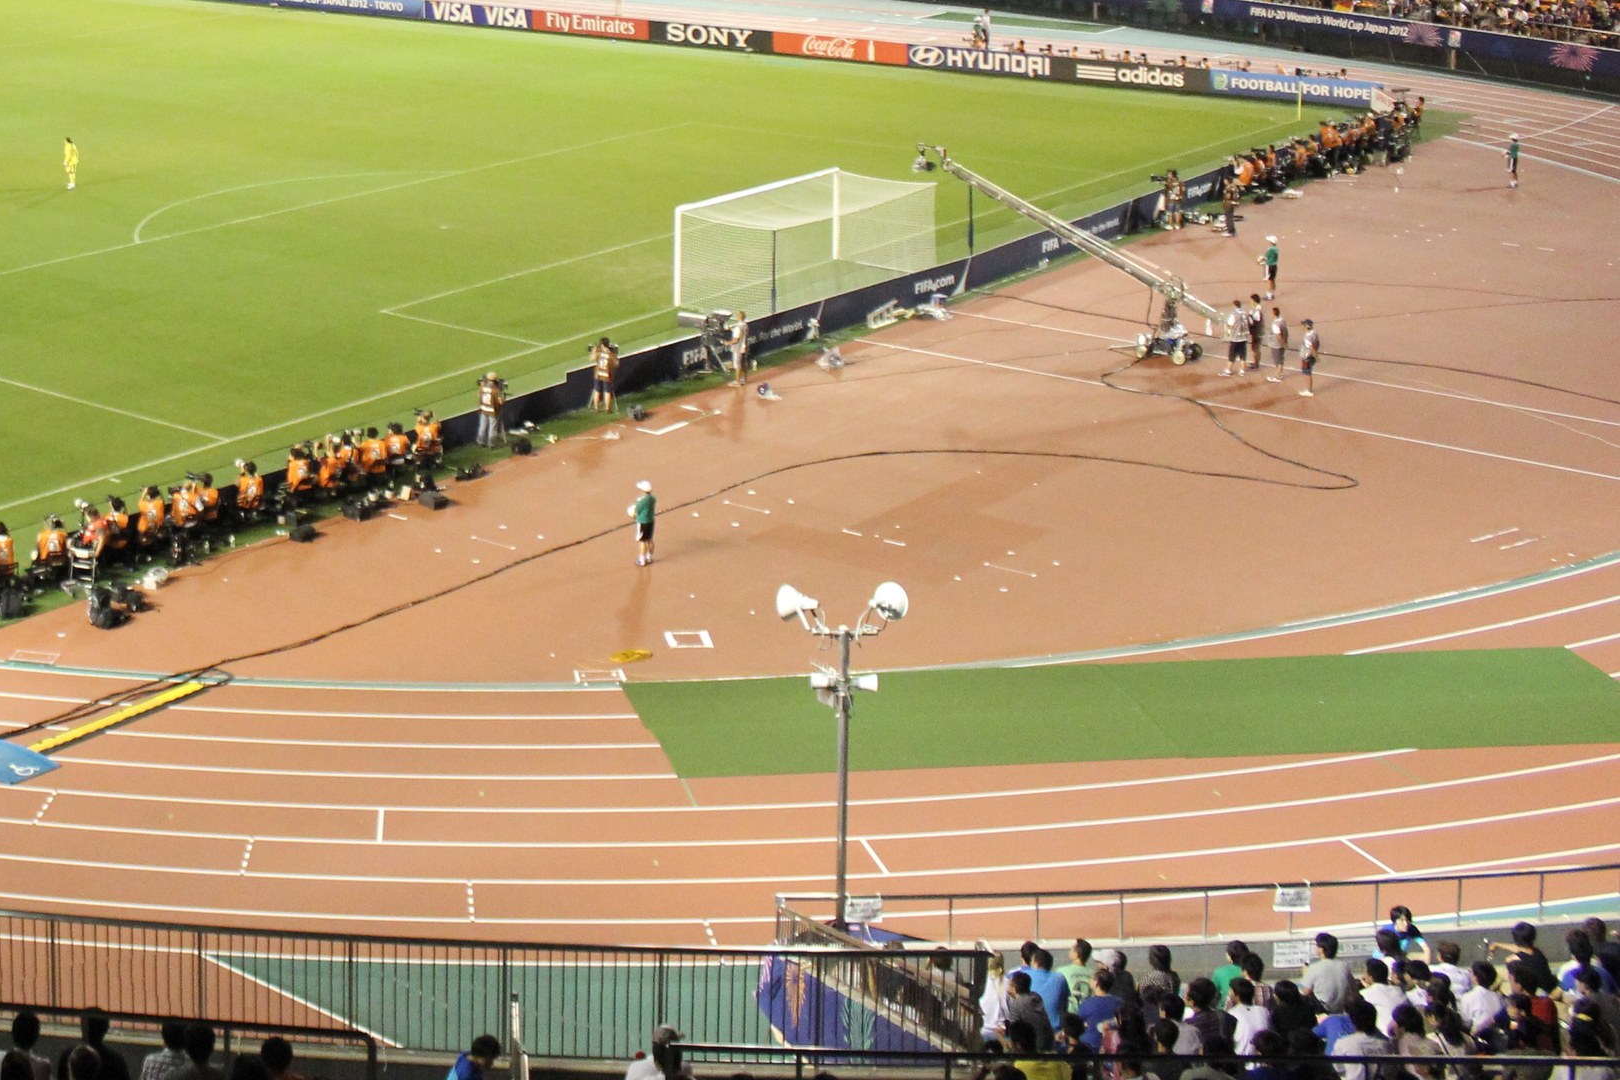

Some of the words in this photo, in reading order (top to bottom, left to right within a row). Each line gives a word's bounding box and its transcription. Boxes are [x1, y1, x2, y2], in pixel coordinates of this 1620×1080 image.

[374, 0, 404, 12] TOKYO
[431, 1, 474, 24] VISA
[482, 5, 528, 29] VISA
[546, 12, 572, 32] Fly
[573, 14, 635, 35] Emirates
[1250, 7, 1267, 18] FIFA
[1268, 9, 1286, 20] U-20
[1286, 11, 1322, 24] Women's
[1323, 16, 1347, 28] World
[1347, 19, 1363, 31] Cup
[1364, 22, 1388, 34] Japan
[1389, 25, 1409, 37] 2012
[666, 23, 753, 48] SONY
[802, 34, 857, 59] Coca-Cola
[947, 49, 1051, 76] HYUNDAI
[1117, 66, 1185, 88] adidas
[1231, 77, 1300, 94] FOOTBALL
[1302, 83, 1330, 97] FOR
[1333, 86, 1371, 100] HOPE
[915, 274, 955, 295] FIFA.com
